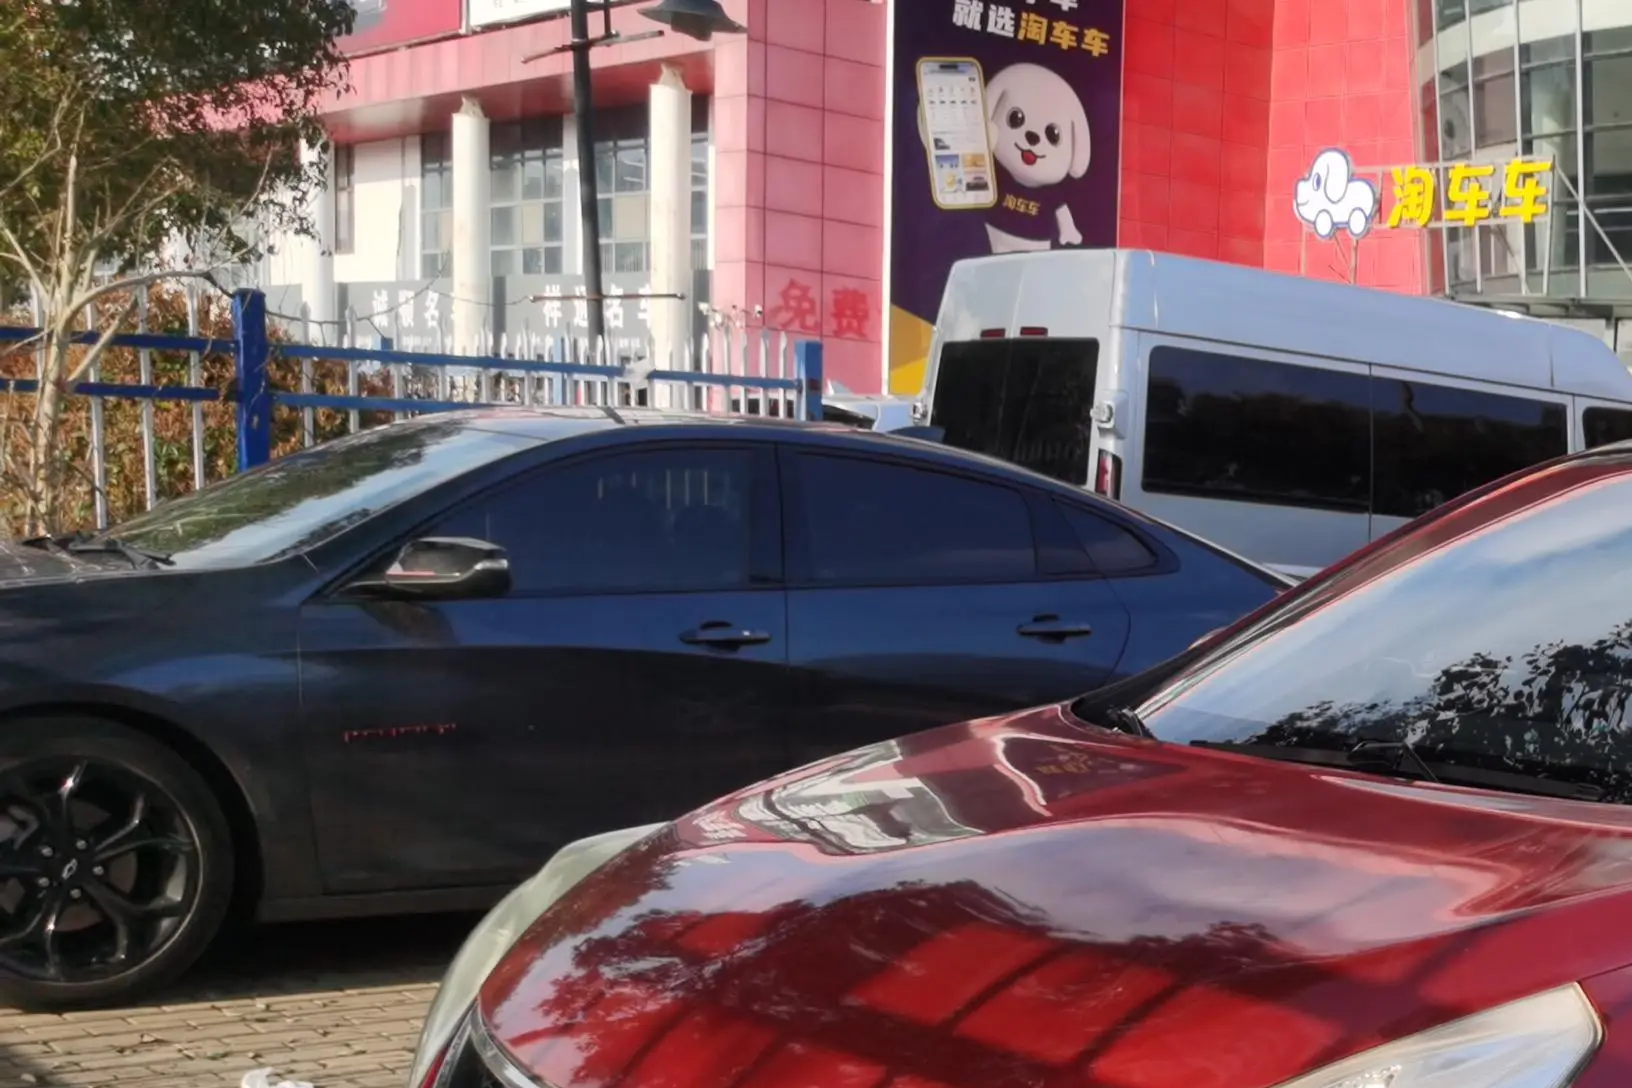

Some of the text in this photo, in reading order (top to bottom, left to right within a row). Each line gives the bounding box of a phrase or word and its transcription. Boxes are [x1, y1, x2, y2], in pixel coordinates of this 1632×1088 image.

[952, 0, 1110, 57] 就选淘车车
[1387, 160, 1556, 229] 淘车车
[769, 278, 869, 338] 免费
